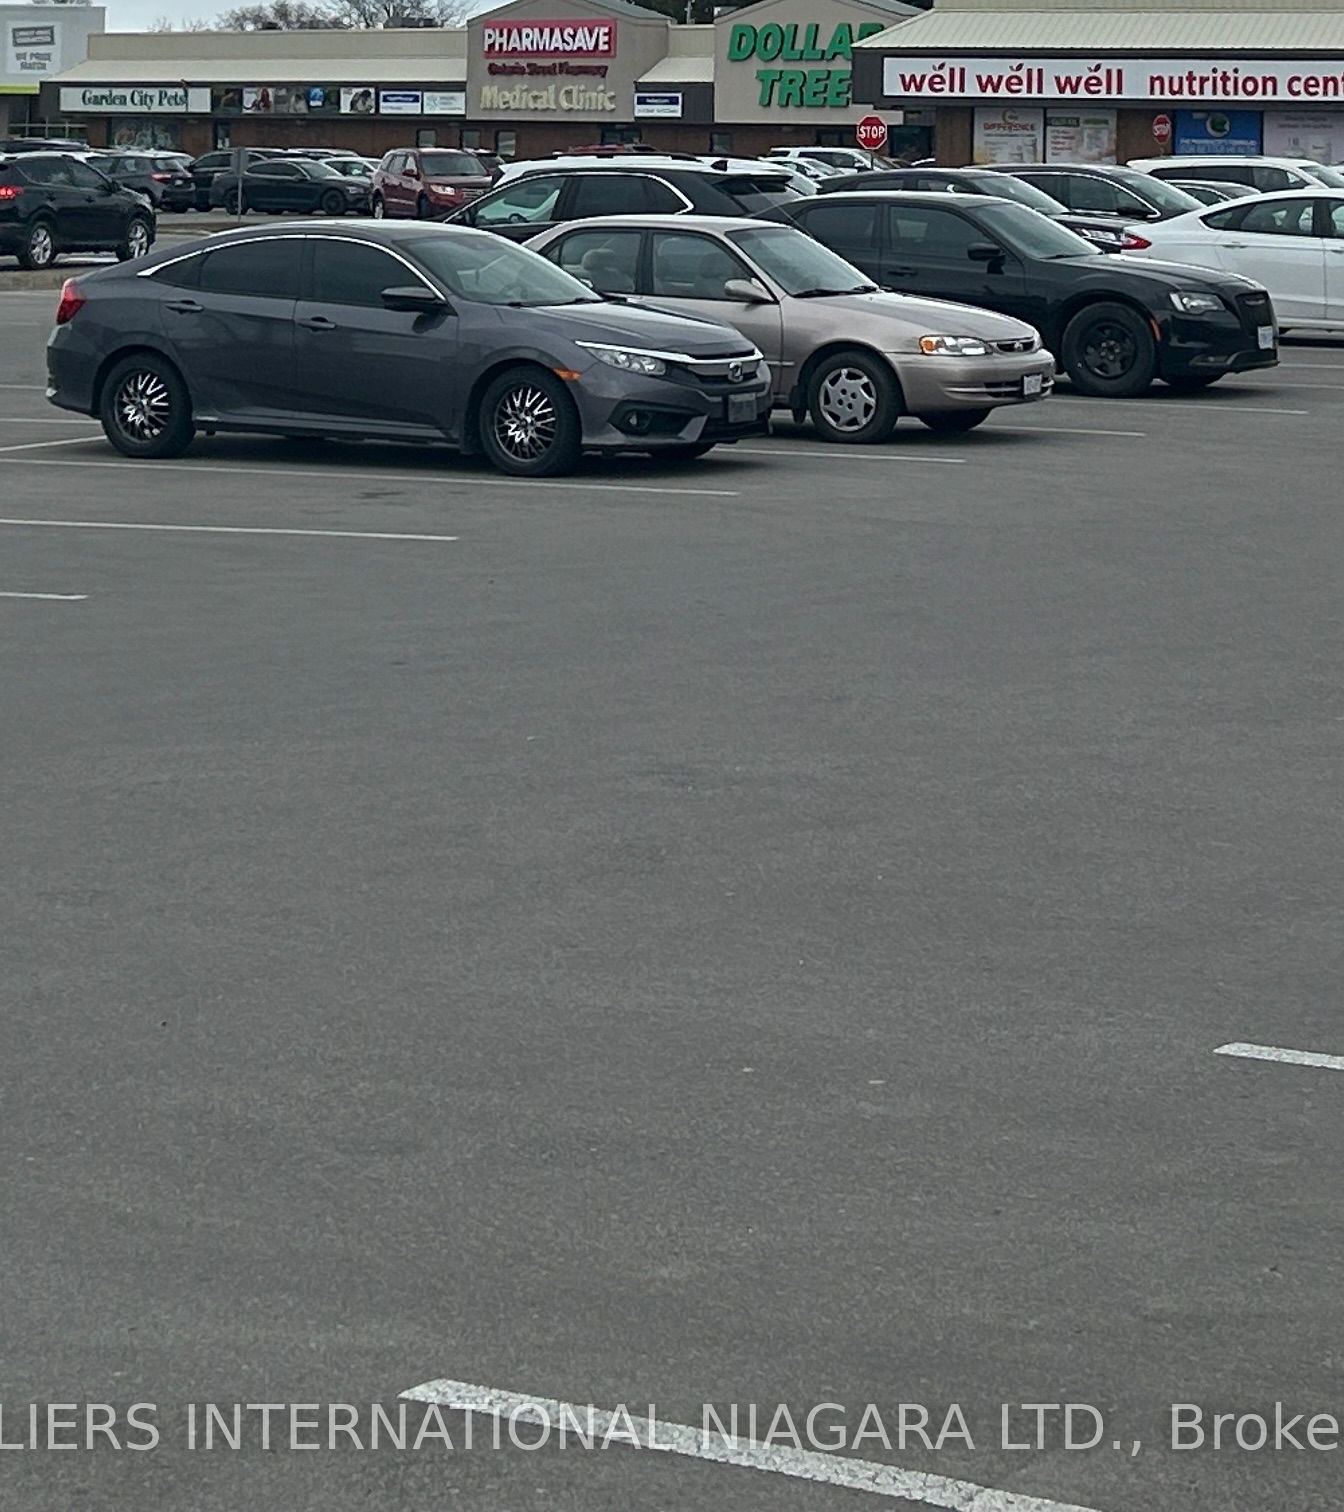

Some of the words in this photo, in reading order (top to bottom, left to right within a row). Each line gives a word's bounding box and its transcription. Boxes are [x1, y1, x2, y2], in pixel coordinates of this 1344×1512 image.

[484, 27, 610, 52] PHARMASAVE
[756, 70, 853, 107] TREE
[1149, 67, 1278, 97] nutrition
[81, 89, 128, 107] Garden
[130, 88, 155, 110] City
[158, 89, 188, 107] Pets
[479, 85, 556, 110] Medical
[558, 85, 617, 112] Clinic
[859, 125, 886, 140] STOP
